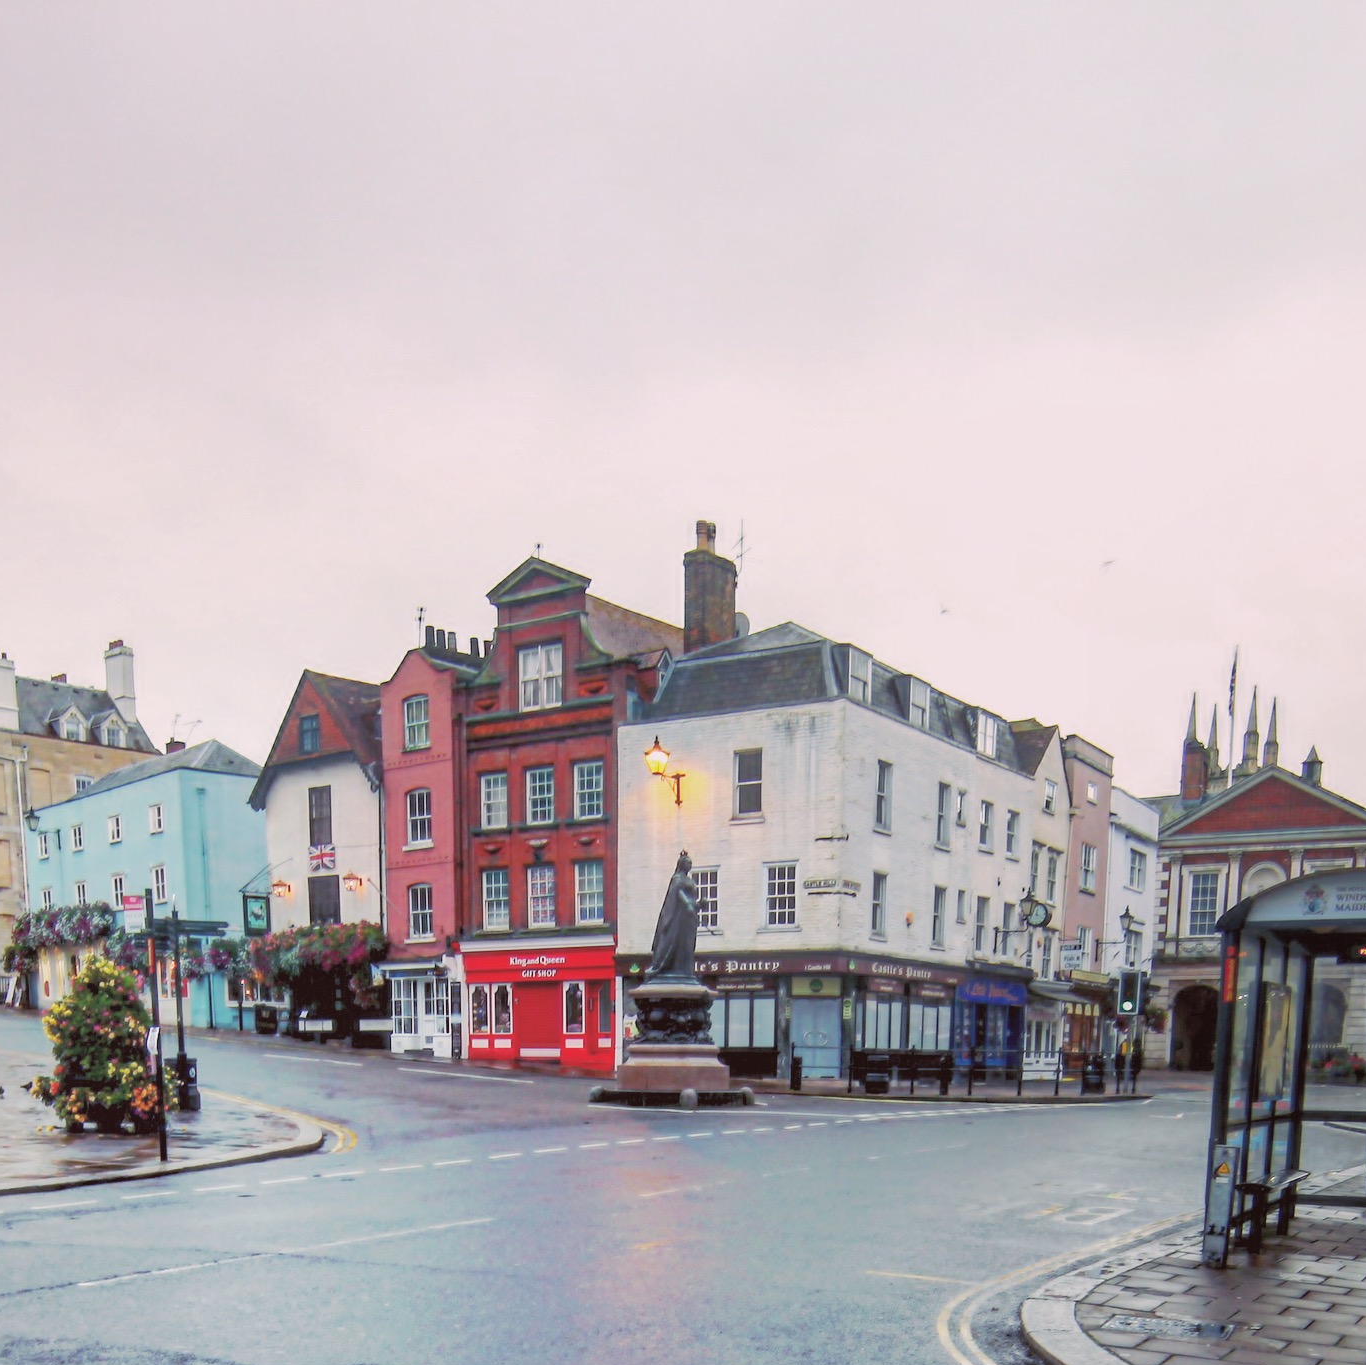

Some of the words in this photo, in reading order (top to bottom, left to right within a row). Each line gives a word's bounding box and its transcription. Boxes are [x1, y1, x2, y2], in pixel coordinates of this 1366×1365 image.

[510, 956, 527, 966] King
[527, 957, 539, 965] and
[539, 956, 566, 965] Queen
[694, 961, 719, 972] le's
[724, 960, 781, 973] Pantry
[522, 970, 536, 978] GIFT
[538, 969, 556, 977] SHOP
[871, 962, 904, 977] Castle's
[906, 966, 932, 979] Pantry
